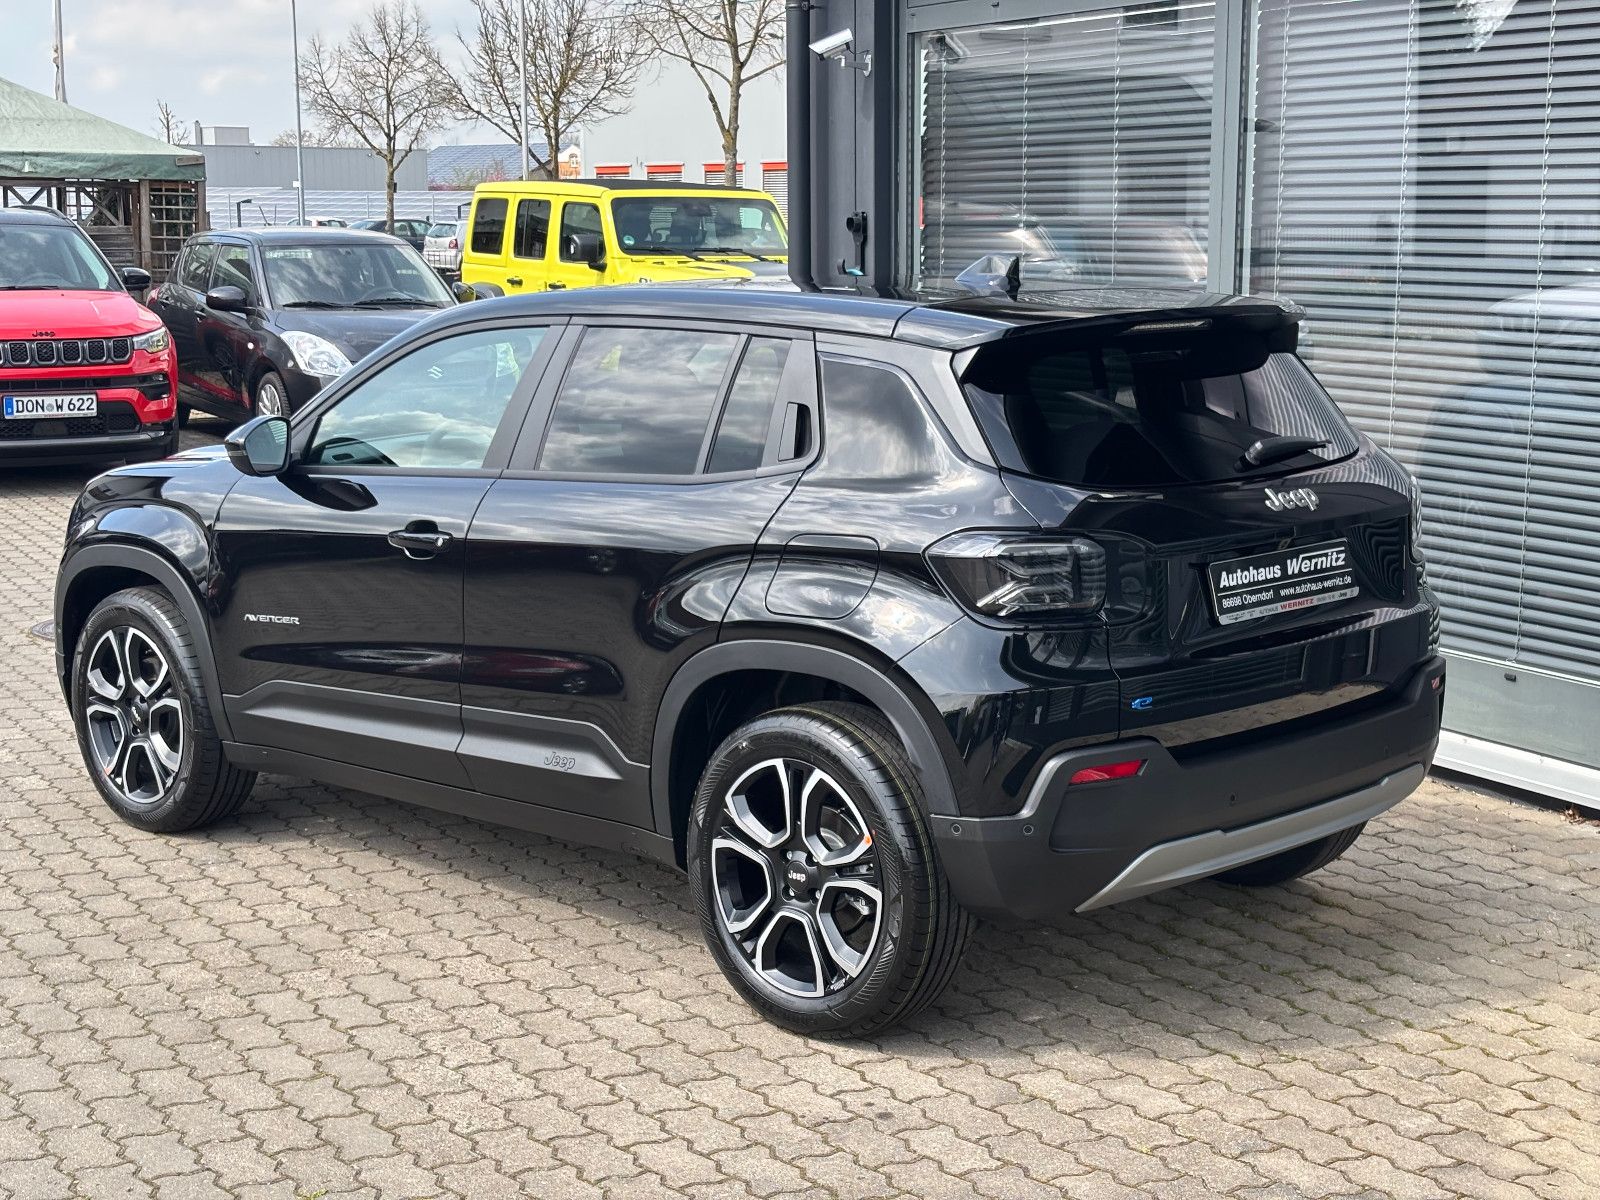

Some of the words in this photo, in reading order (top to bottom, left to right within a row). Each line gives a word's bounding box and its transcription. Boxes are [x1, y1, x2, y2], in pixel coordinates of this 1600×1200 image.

[15, 399, 45, 413] DON
[55, 398, 64, 412] W
[67, 397, 95, 411] 622
[1264, 487, 1319, 511] Jeep
[1219, 564, 1281, 588] Autohaus
[1286, 547, 1346, 575] Wernitz
[1222, 596, 1242, 608] 86698
[1242, 589, 1274, 604] Oberndorf
[1279, 575, 1352, 597] www.autohaus-wernitz.de
[1280, 598, 1314, 610] WERNITZ
[243, 613, 300, 625] AVENGER
[543, 751, 576, 771] Jeep
[788, 870, 806, 883] Jeep
